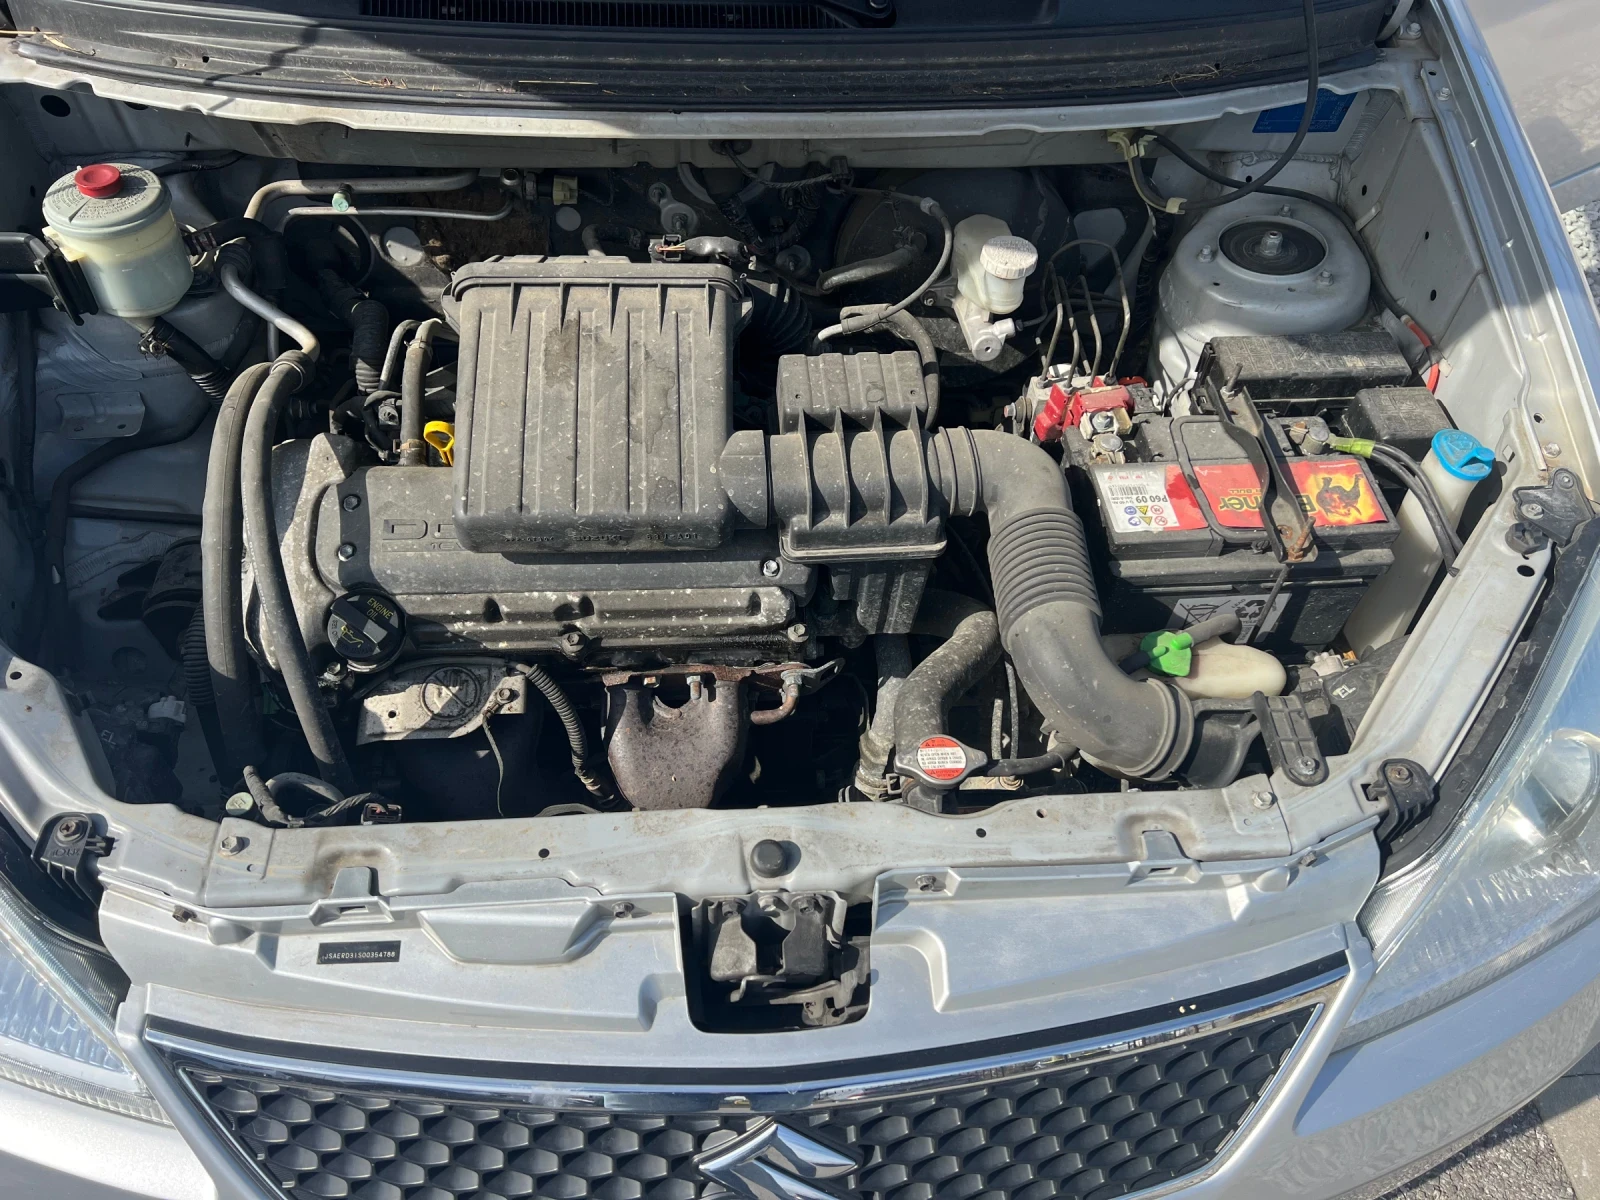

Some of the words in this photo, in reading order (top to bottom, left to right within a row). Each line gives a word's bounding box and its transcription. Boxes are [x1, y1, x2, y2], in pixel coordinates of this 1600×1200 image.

[1135, 496, 1148, 504] 09
[1149, 495, 1169, 504] P60
[1218, 494, 1318, 513] Bner
[367, 597, 394, 619] ENGINE
[1231, 598, 1246, 609] LEAD
[366, 608, 379, 620] OIL
